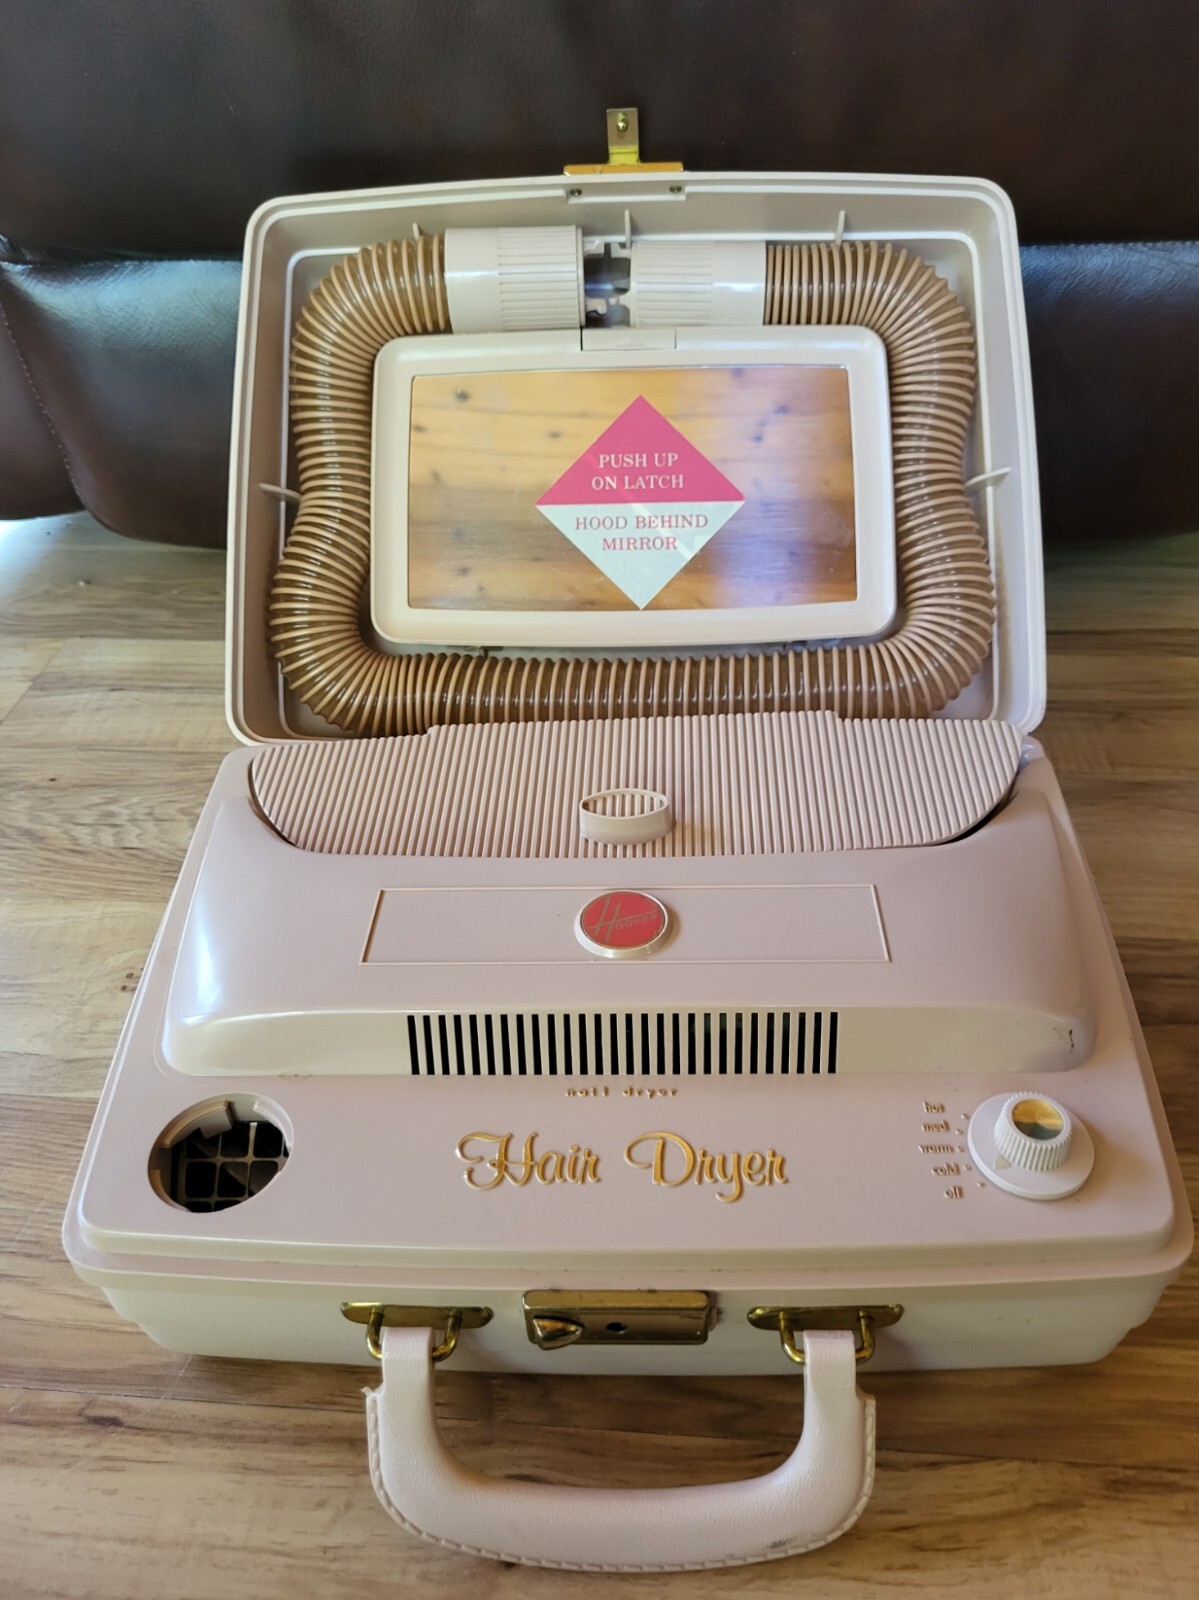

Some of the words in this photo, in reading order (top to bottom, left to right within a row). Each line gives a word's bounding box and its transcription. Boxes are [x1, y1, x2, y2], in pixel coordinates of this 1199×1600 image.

[599, 453, 647, 468] PUSH
[654, 452, 678, 467] UP
[591, 475, 617, 490] ON
[624, 474, 684, 489] LATCH
[575, 516, 628, 530] HOOD
[635, 514, 708, 529] BEHIND
[602, 536, 678, 551] MIRROR
[566, 1086, 609, 1097] nail
[622, 1086, 678, 1099] dryer
[922, 1101, 946, 1114] hot
[455, 1132, 602, 1190] Hair
[624, 1131, 790, 1203] Dryer
[931, 1162, 961, 1177] cold
